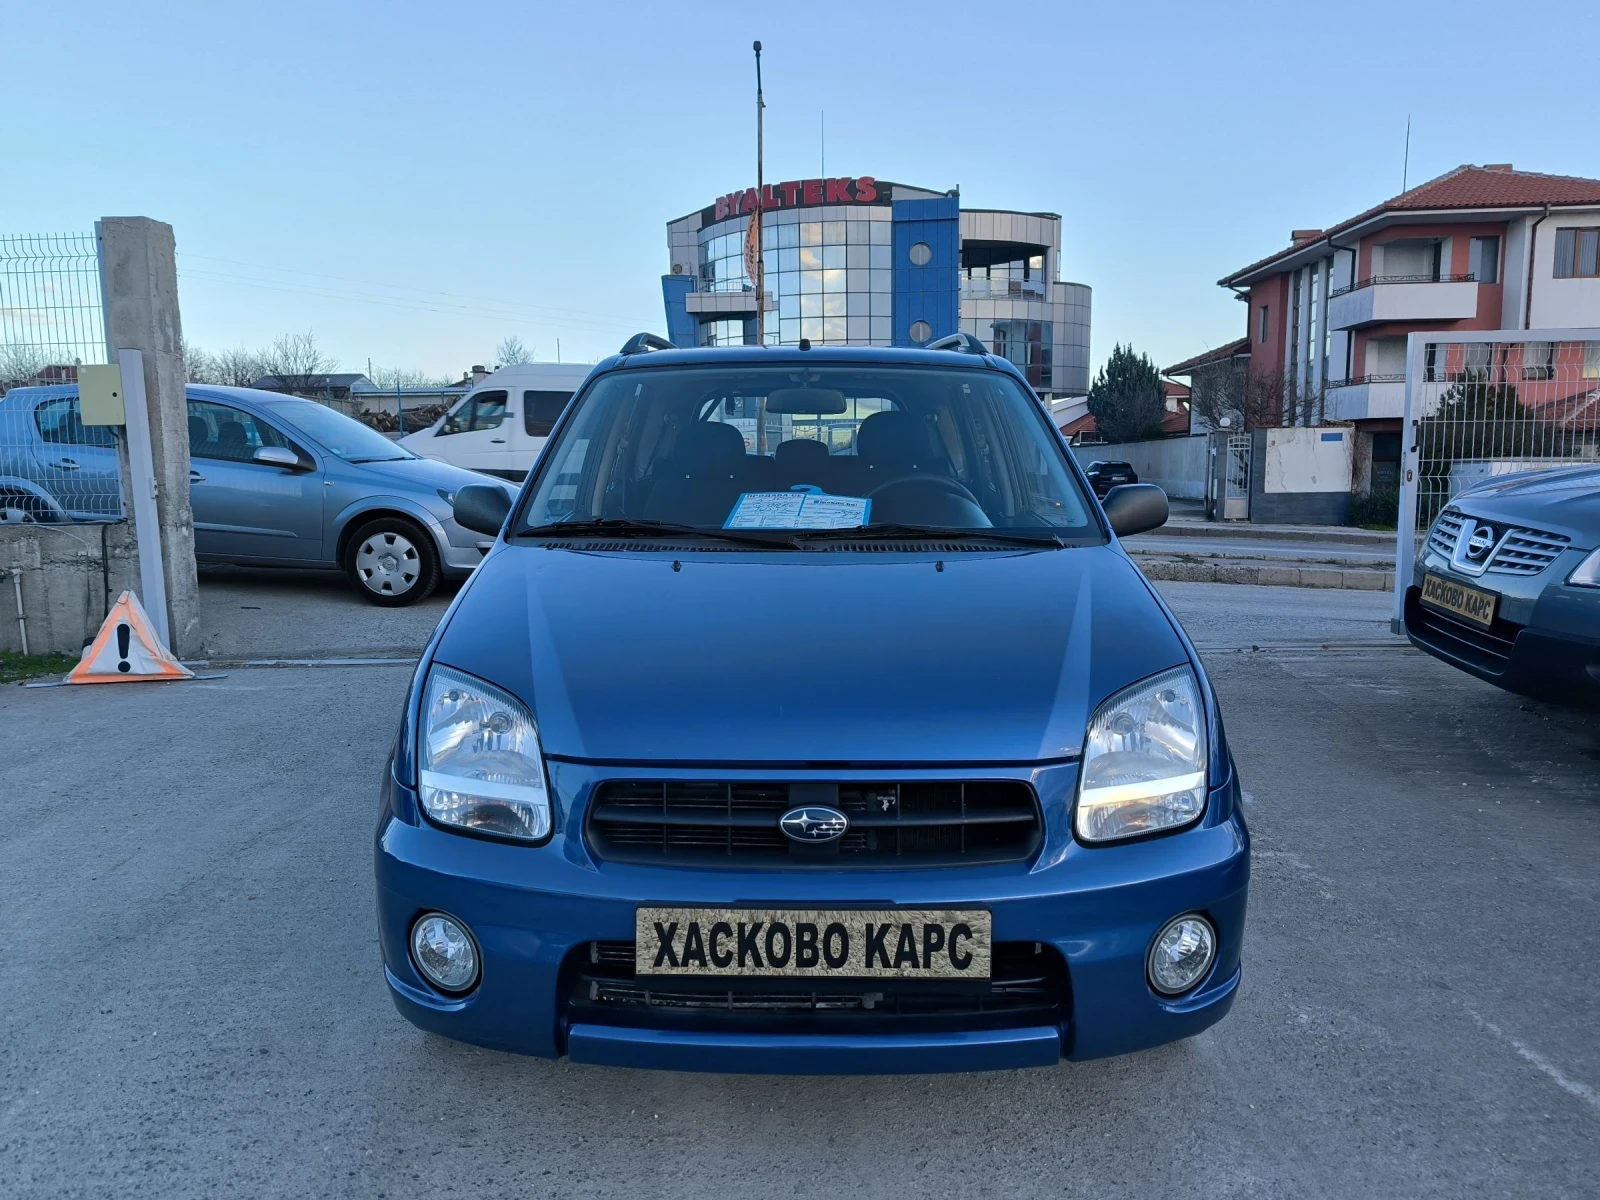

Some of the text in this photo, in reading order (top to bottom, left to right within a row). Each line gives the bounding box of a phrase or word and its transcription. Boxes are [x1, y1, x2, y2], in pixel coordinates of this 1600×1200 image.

[715, 176, 877, 221] BYALTEKS
[1424, 578, 1491, 620] ХАСКОВО КАРС
[653, 921, 974, 970] ХАСКОВО КАРС
